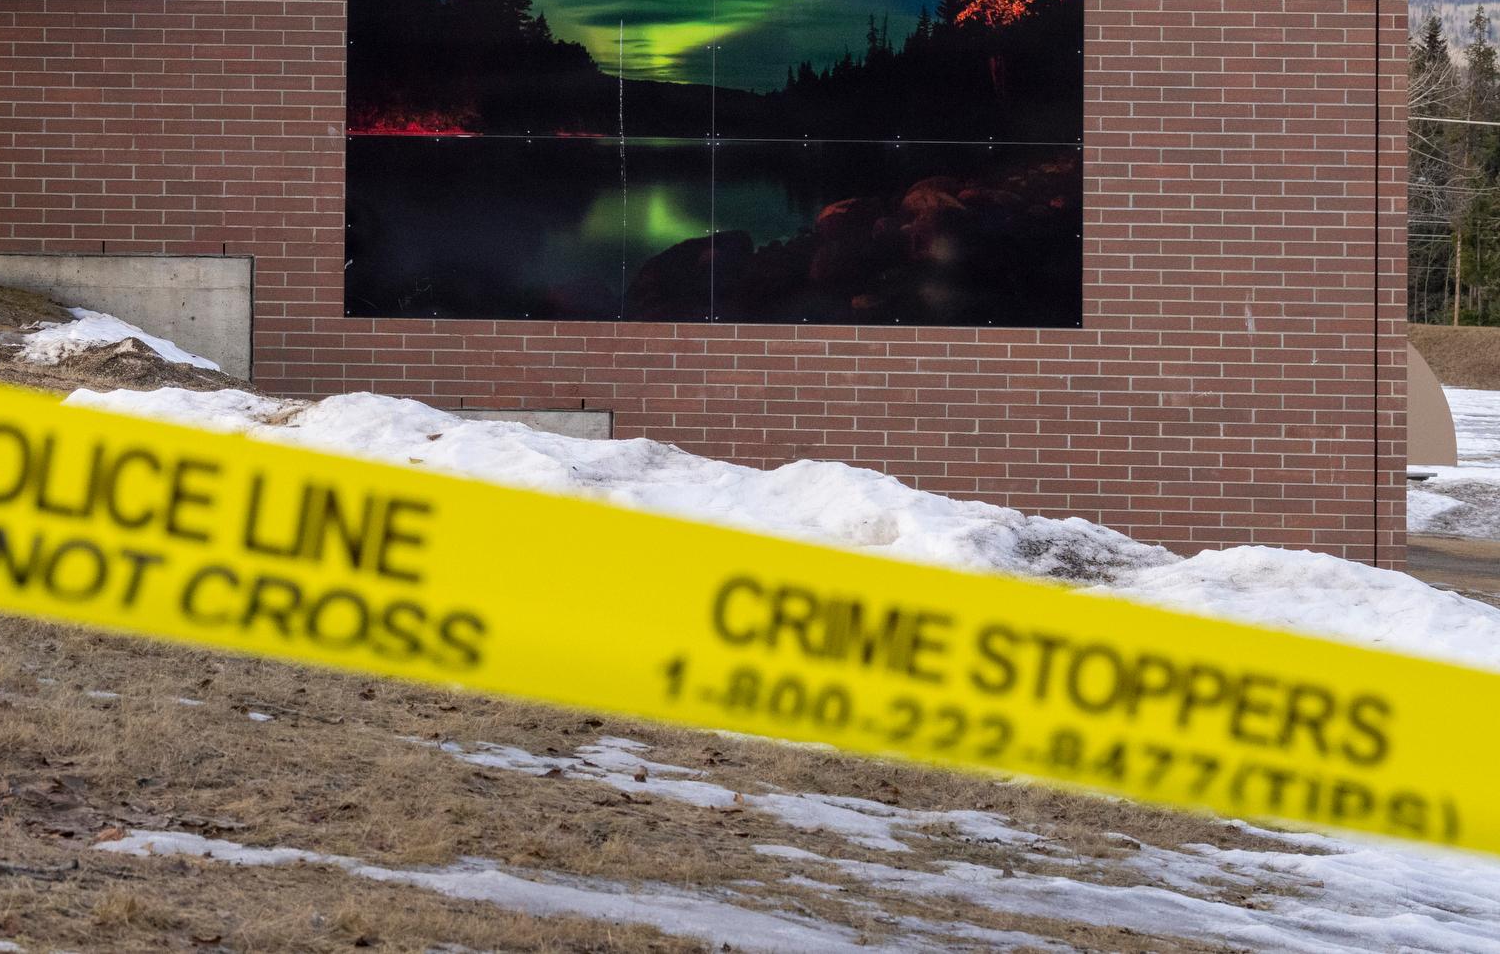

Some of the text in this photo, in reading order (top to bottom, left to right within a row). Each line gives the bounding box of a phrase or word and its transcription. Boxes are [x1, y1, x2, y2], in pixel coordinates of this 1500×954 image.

[240, 472, 434, 584] LINE
[178, 563, 487, 671] CROSS
[712, 574, 1394, 768] CRIME STOPPERS
